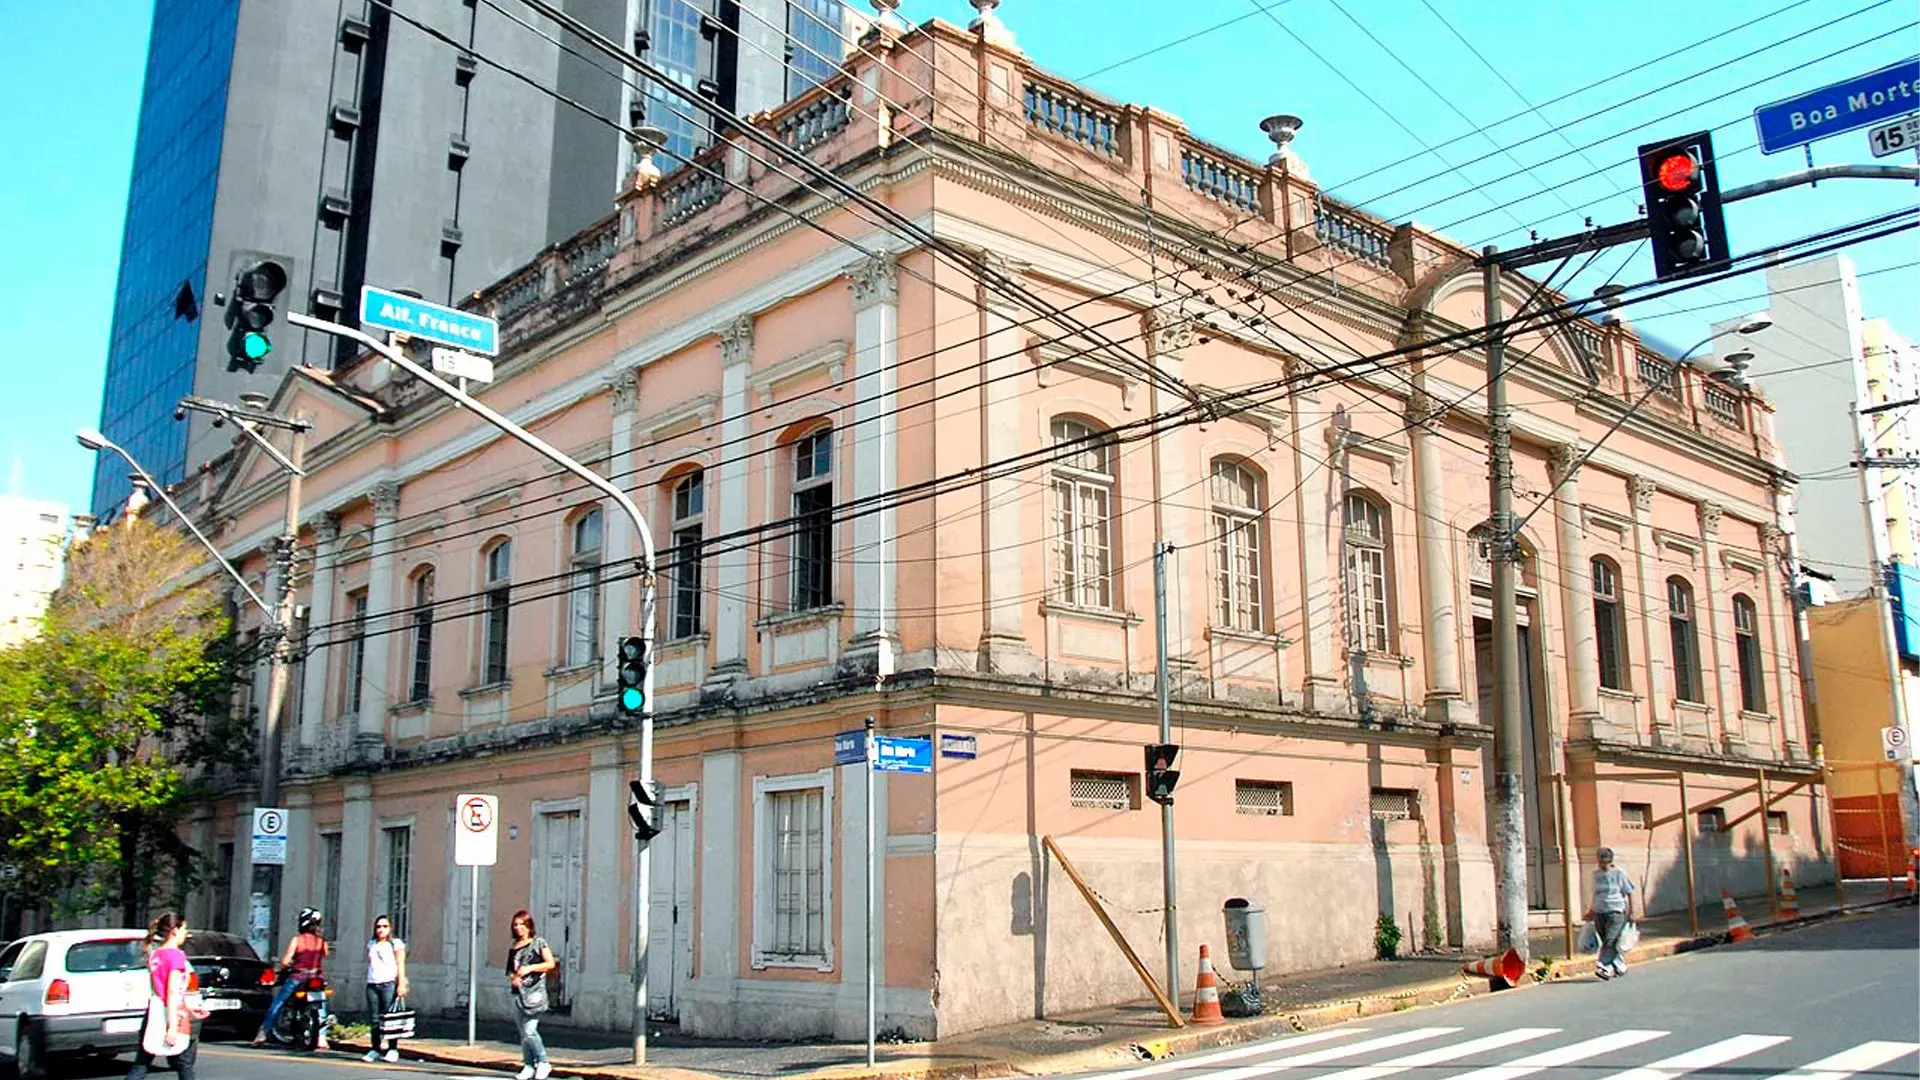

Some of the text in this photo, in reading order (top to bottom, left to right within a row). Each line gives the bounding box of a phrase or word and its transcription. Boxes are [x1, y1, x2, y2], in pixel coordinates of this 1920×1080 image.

[1789, 105, 1838, 131] Boa
[1874, 126, 1904, 151] 15
[267, 816, 275, 829] E
